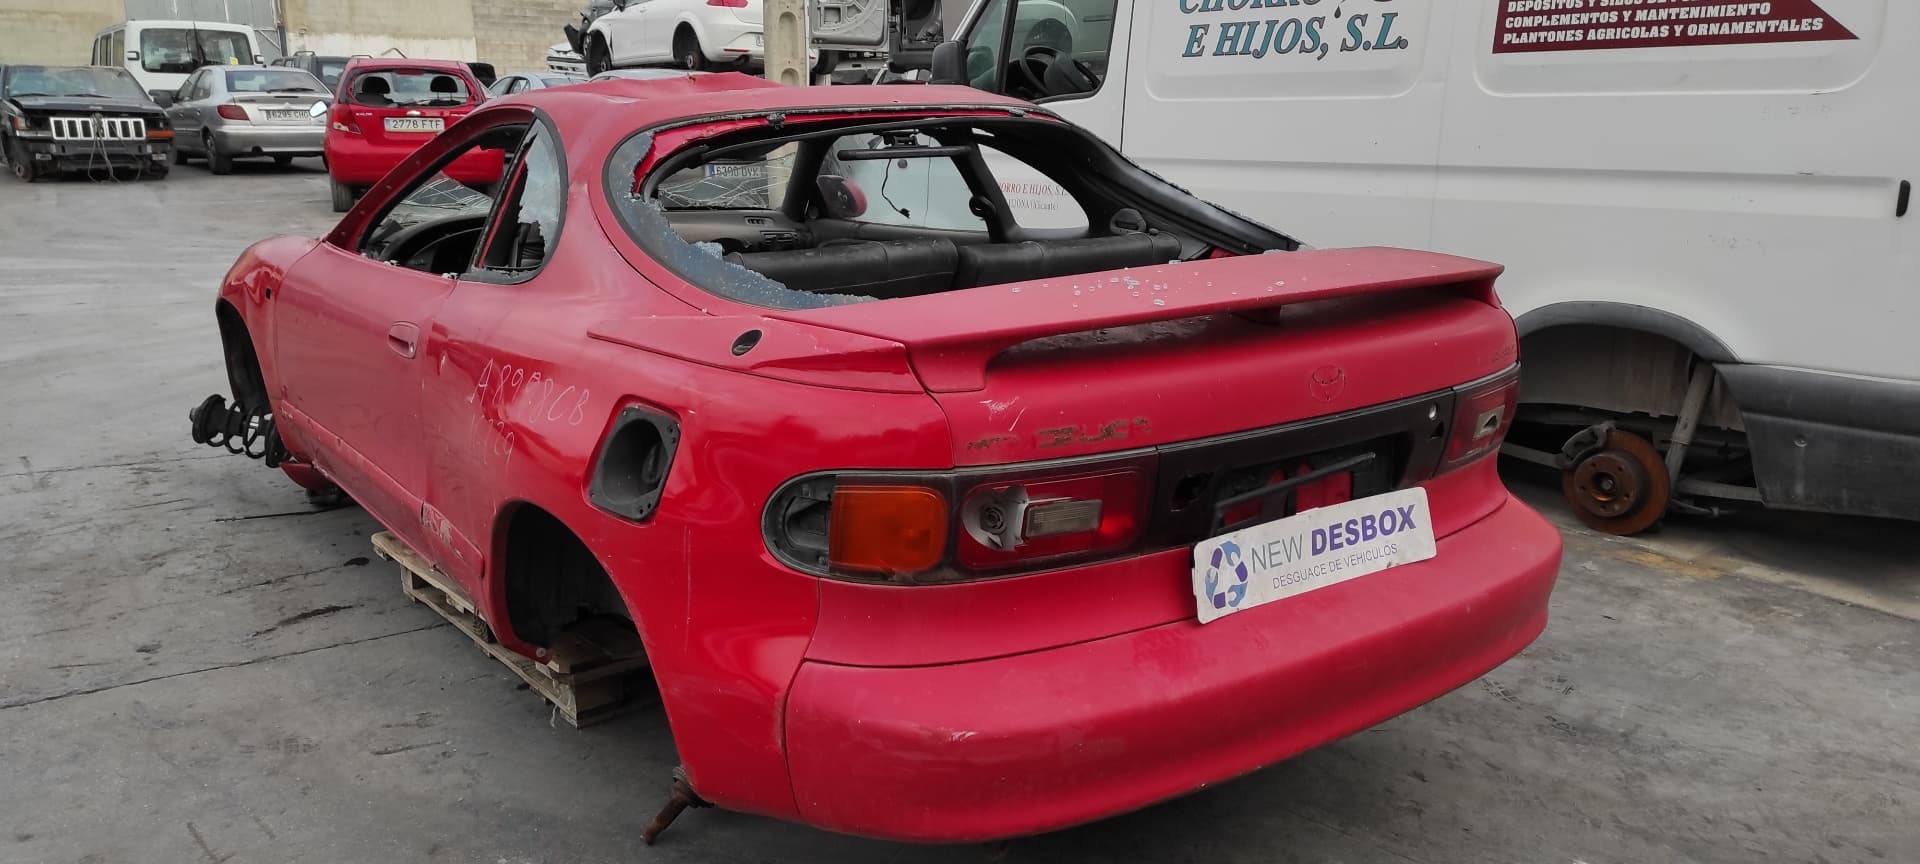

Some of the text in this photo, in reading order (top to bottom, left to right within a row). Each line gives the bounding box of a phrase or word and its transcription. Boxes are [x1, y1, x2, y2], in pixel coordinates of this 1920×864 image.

[1505, 2, 1771, 29] COMPLEMENTOS Y MANTENIMIENTO
[1182, 12, 1409, 61] E HIJOS, S.L.
[1503, 17, 1824, 45] PLANTONES AGRICOLAS Y ORNAMENTALES
[392, 119, 441, 129] 2778 FTF
[1251, 504, 1417, 574] NEW DESBOX
[1272, 566, 1327, 590] DESGUACE
[1329, 560, 1342, 572] DE
